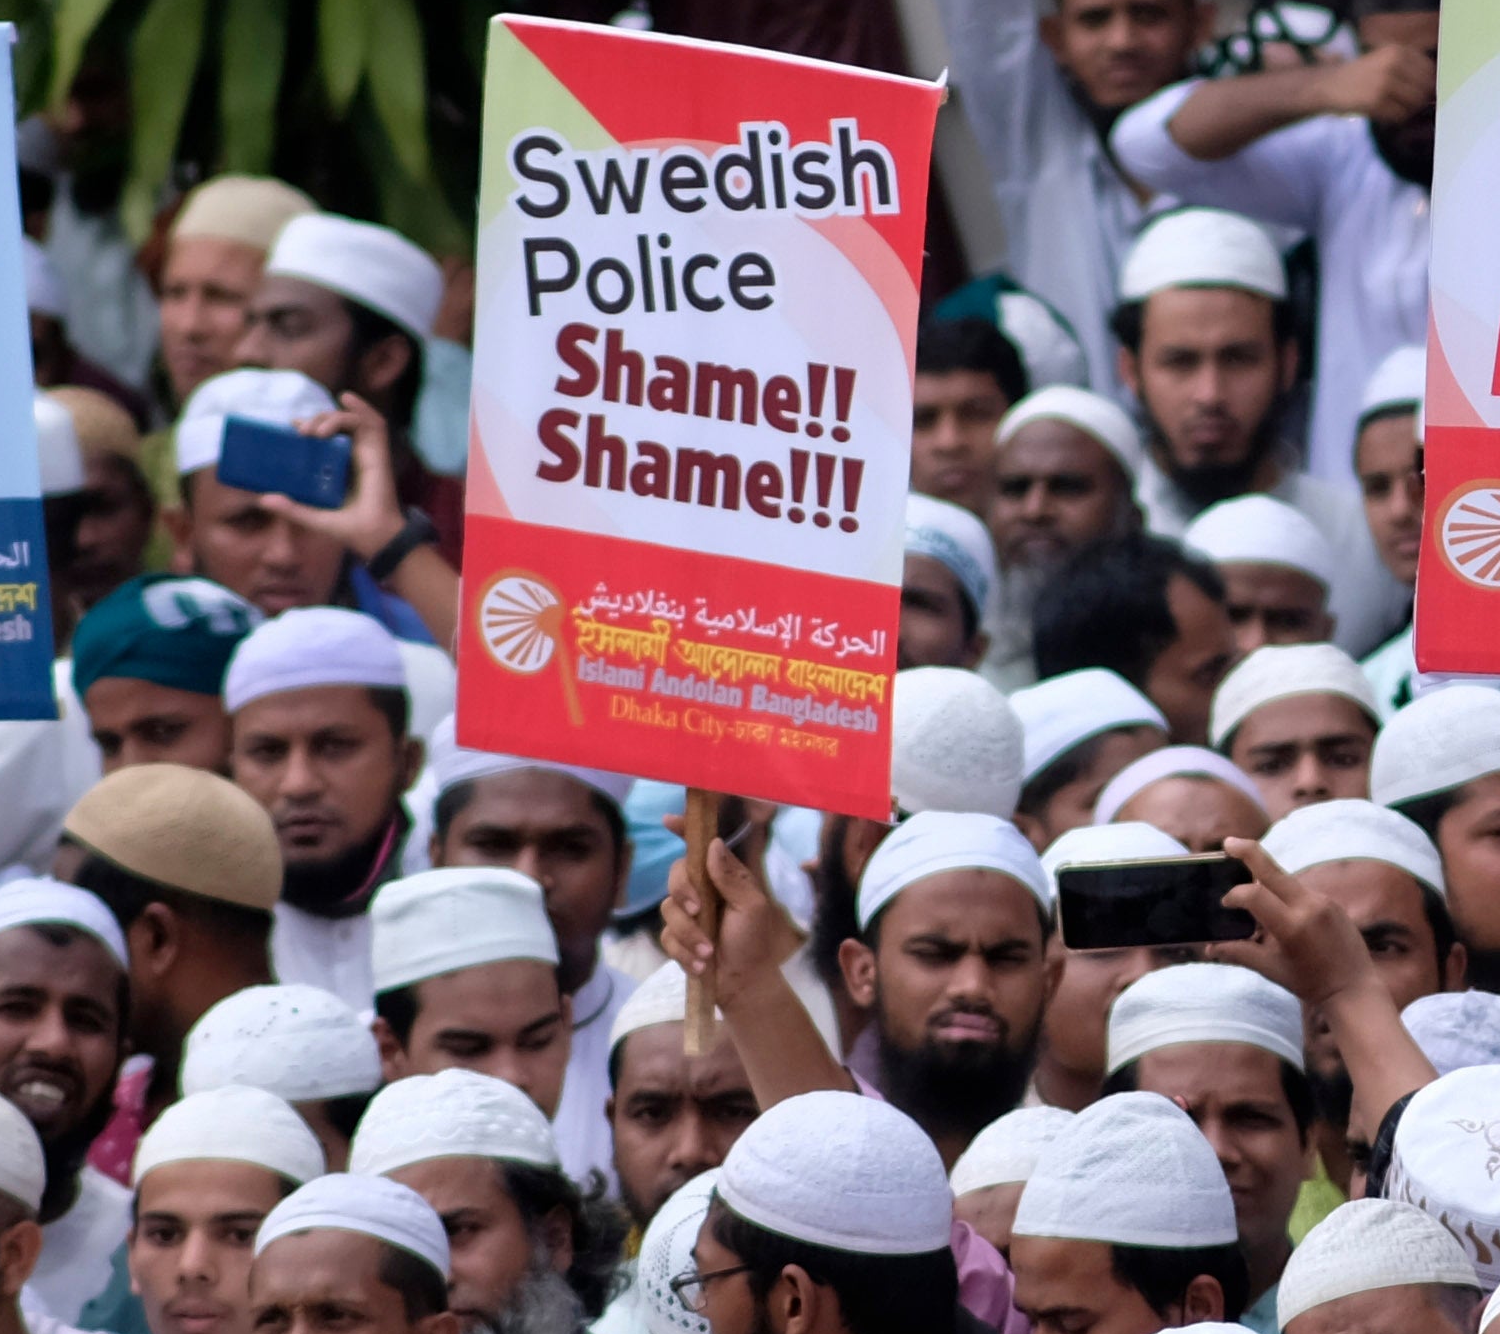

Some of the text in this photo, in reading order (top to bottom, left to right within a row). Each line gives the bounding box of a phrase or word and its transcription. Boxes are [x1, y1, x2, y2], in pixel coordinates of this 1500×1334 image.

[512, 126, 893, 219] Swedish
[522, 232, 777, 317] Police
[553, 322, 858, 444] Shame!!
[535, 407, 866, 534] Shame!!!
[578, 581, 687, 625] بنغلاديش
[808, 616, 887, 659] الحركة
[571, 606, 887, 705] ইসলামী আন্দোলন বাংলাদেশ
[577, 654, 879, 733] Islami Andolan Bangladesh
[610, 693, 680, 730] Dhaka
